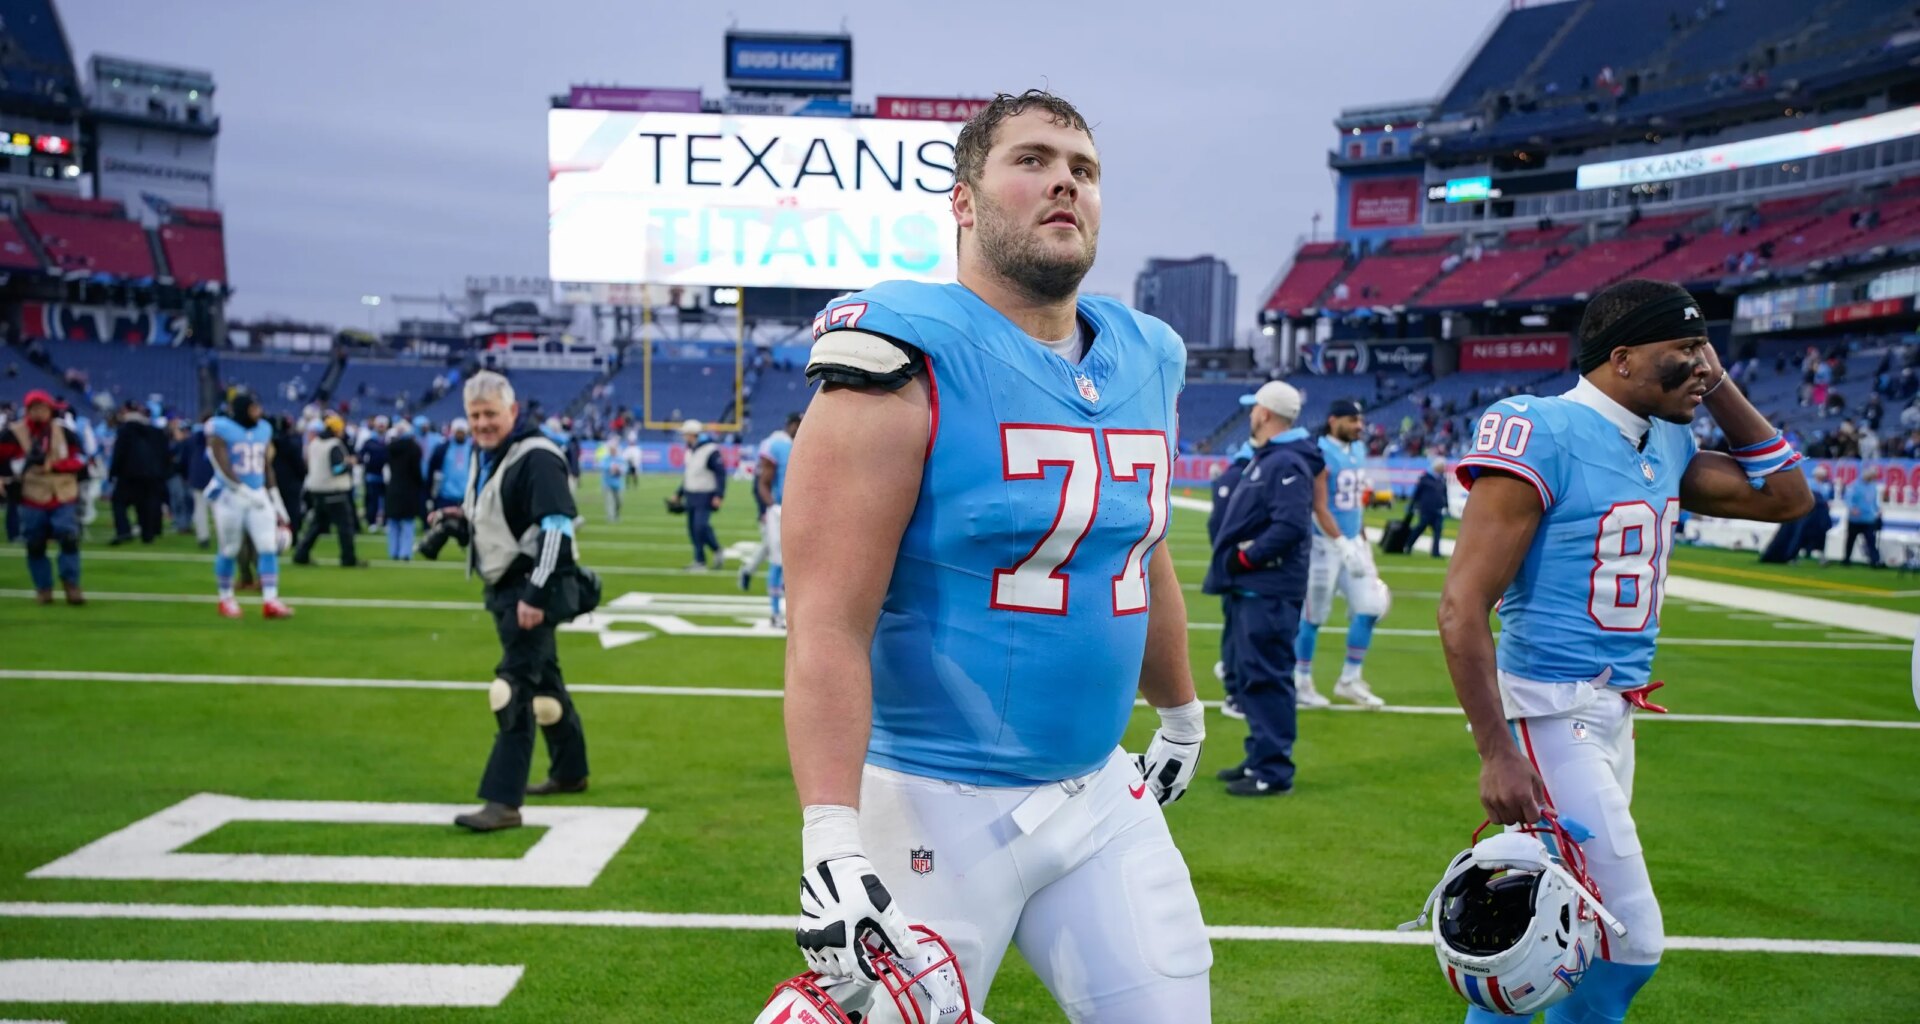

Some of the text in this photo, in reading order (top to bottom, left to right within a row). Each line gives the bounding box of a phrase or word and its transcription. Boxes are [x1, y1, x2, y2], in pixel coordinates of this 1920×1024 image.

[736, 51, 837, 71] BUD LIGHT
[639, 132, 956, 193] TEXANS
[1618, 152, 1704, 180] TEXANS
[649, 208, 941, 273] TITANS
[1472, 341, 1557, 359] NISSAN
[1476, 412, 1534, 457] 80
[990, 422, 1171, 616] 77
[912, 858, 932, 872] NFL
